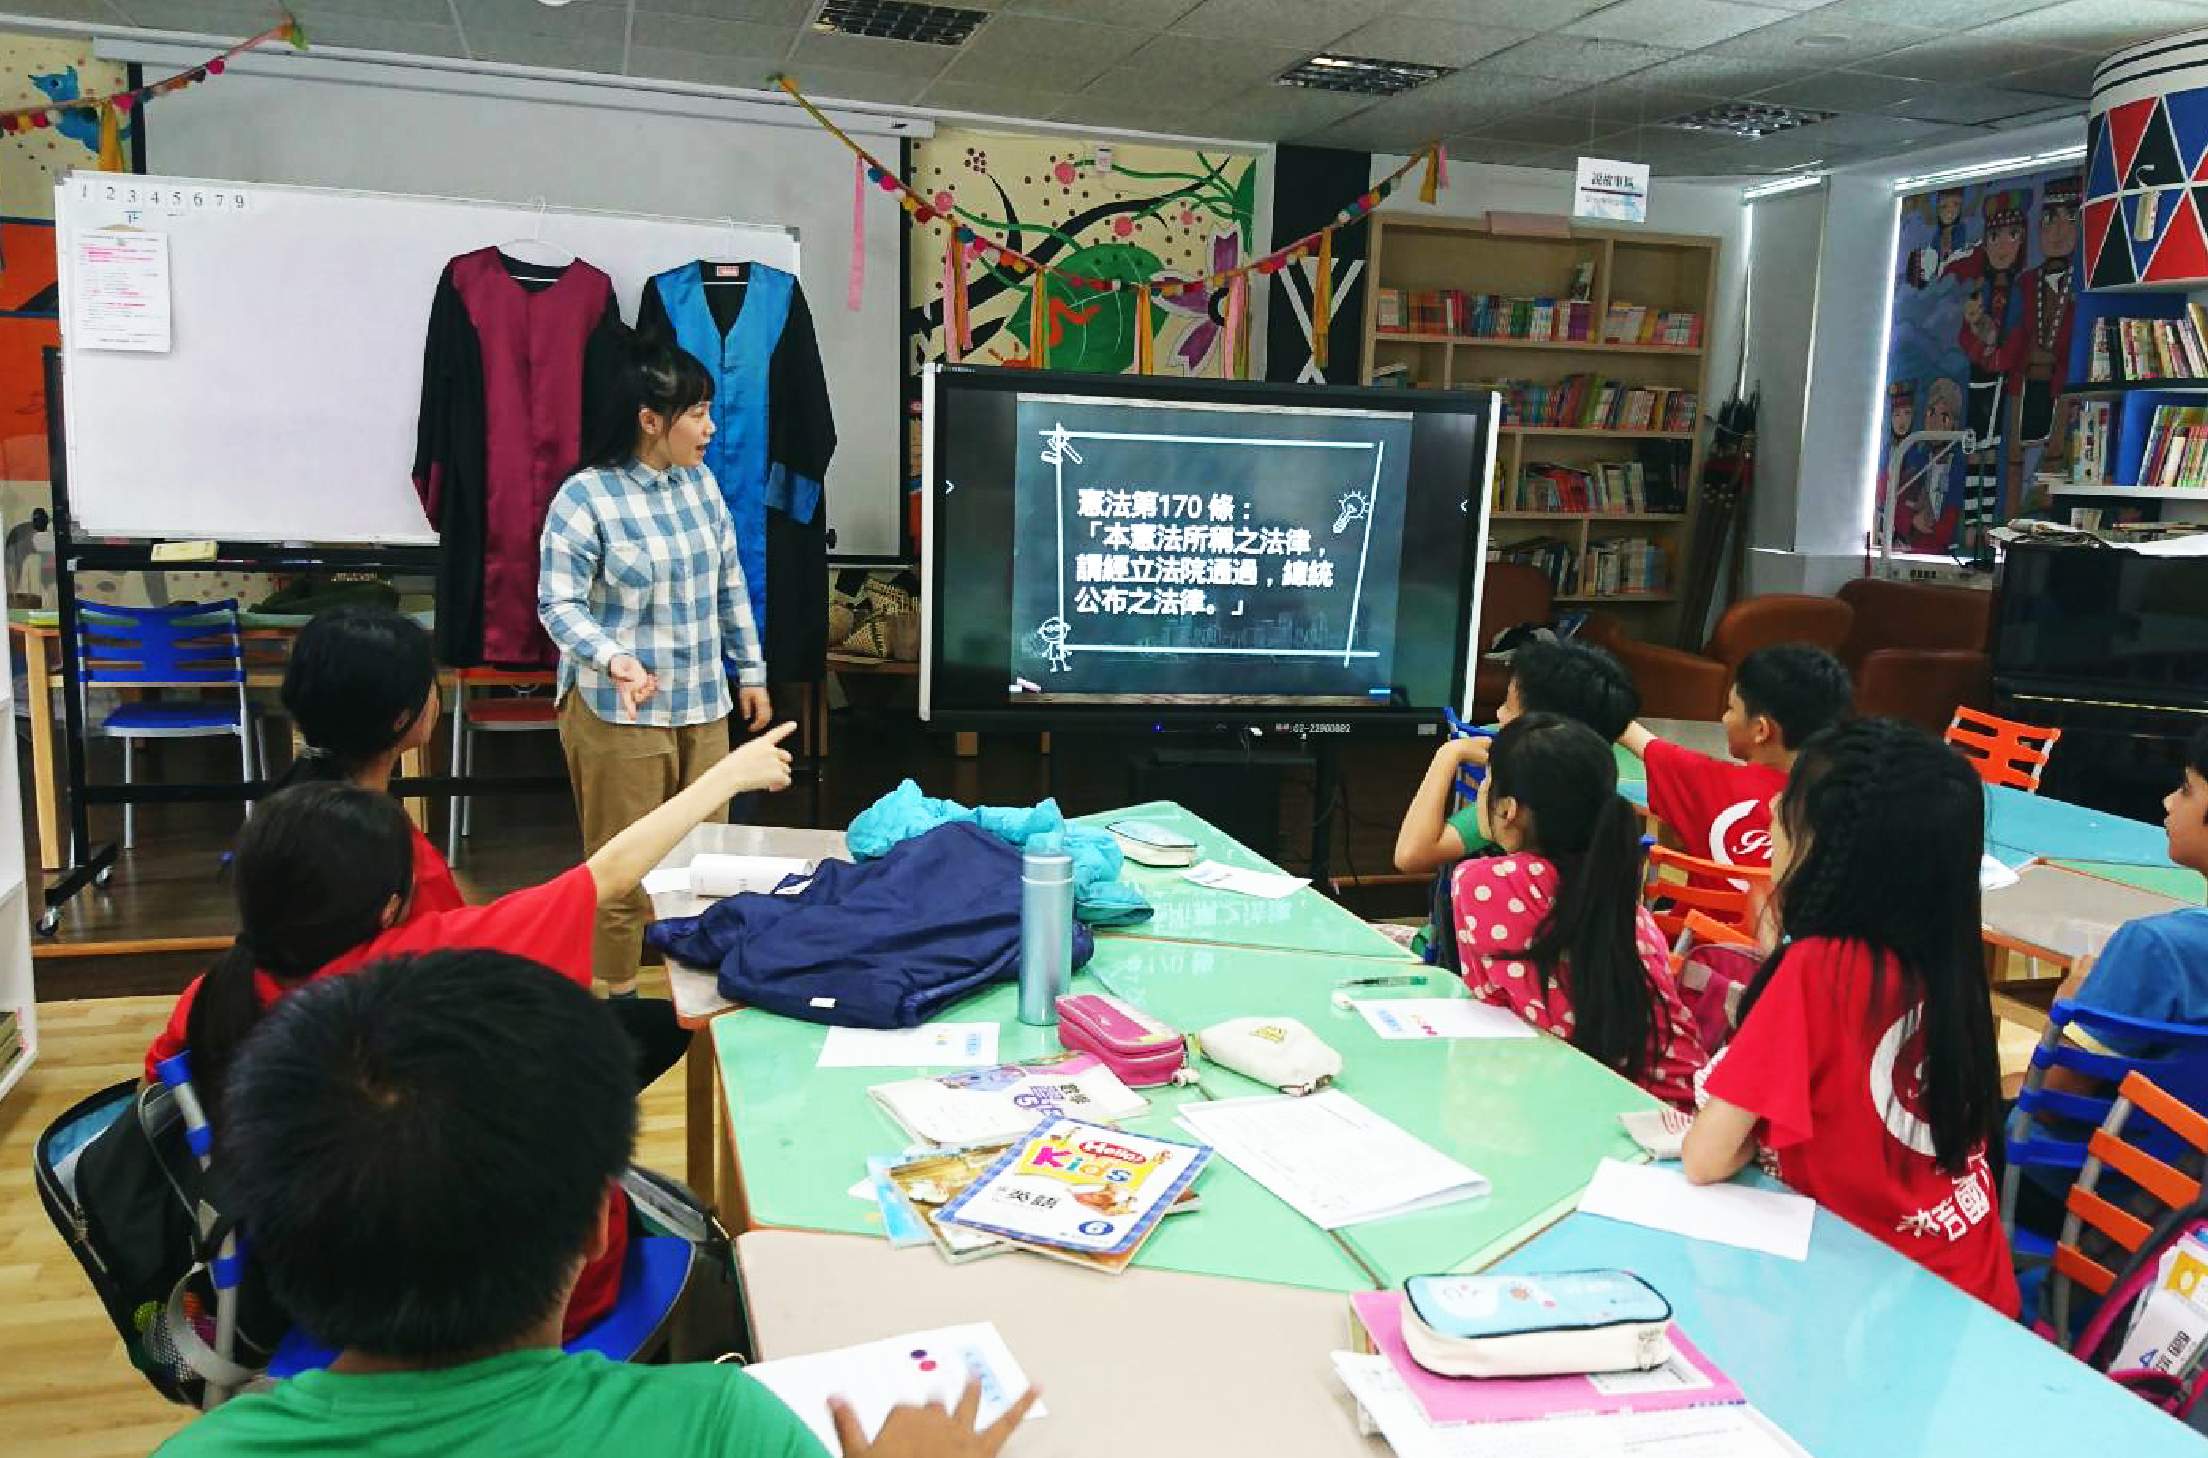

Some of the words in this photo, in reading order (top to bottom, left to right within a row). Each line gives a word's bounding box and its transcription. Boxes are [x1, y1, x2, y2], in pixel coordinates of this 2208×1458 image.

[106, 186, 116, 201] 2
[128, 190, 137, 203] 3
[150, 191, 160, 204] 4
[172, 191, 181, 206] 5
[193, 191, 203, 206] 6
[214, 194, 224, 207] 7
